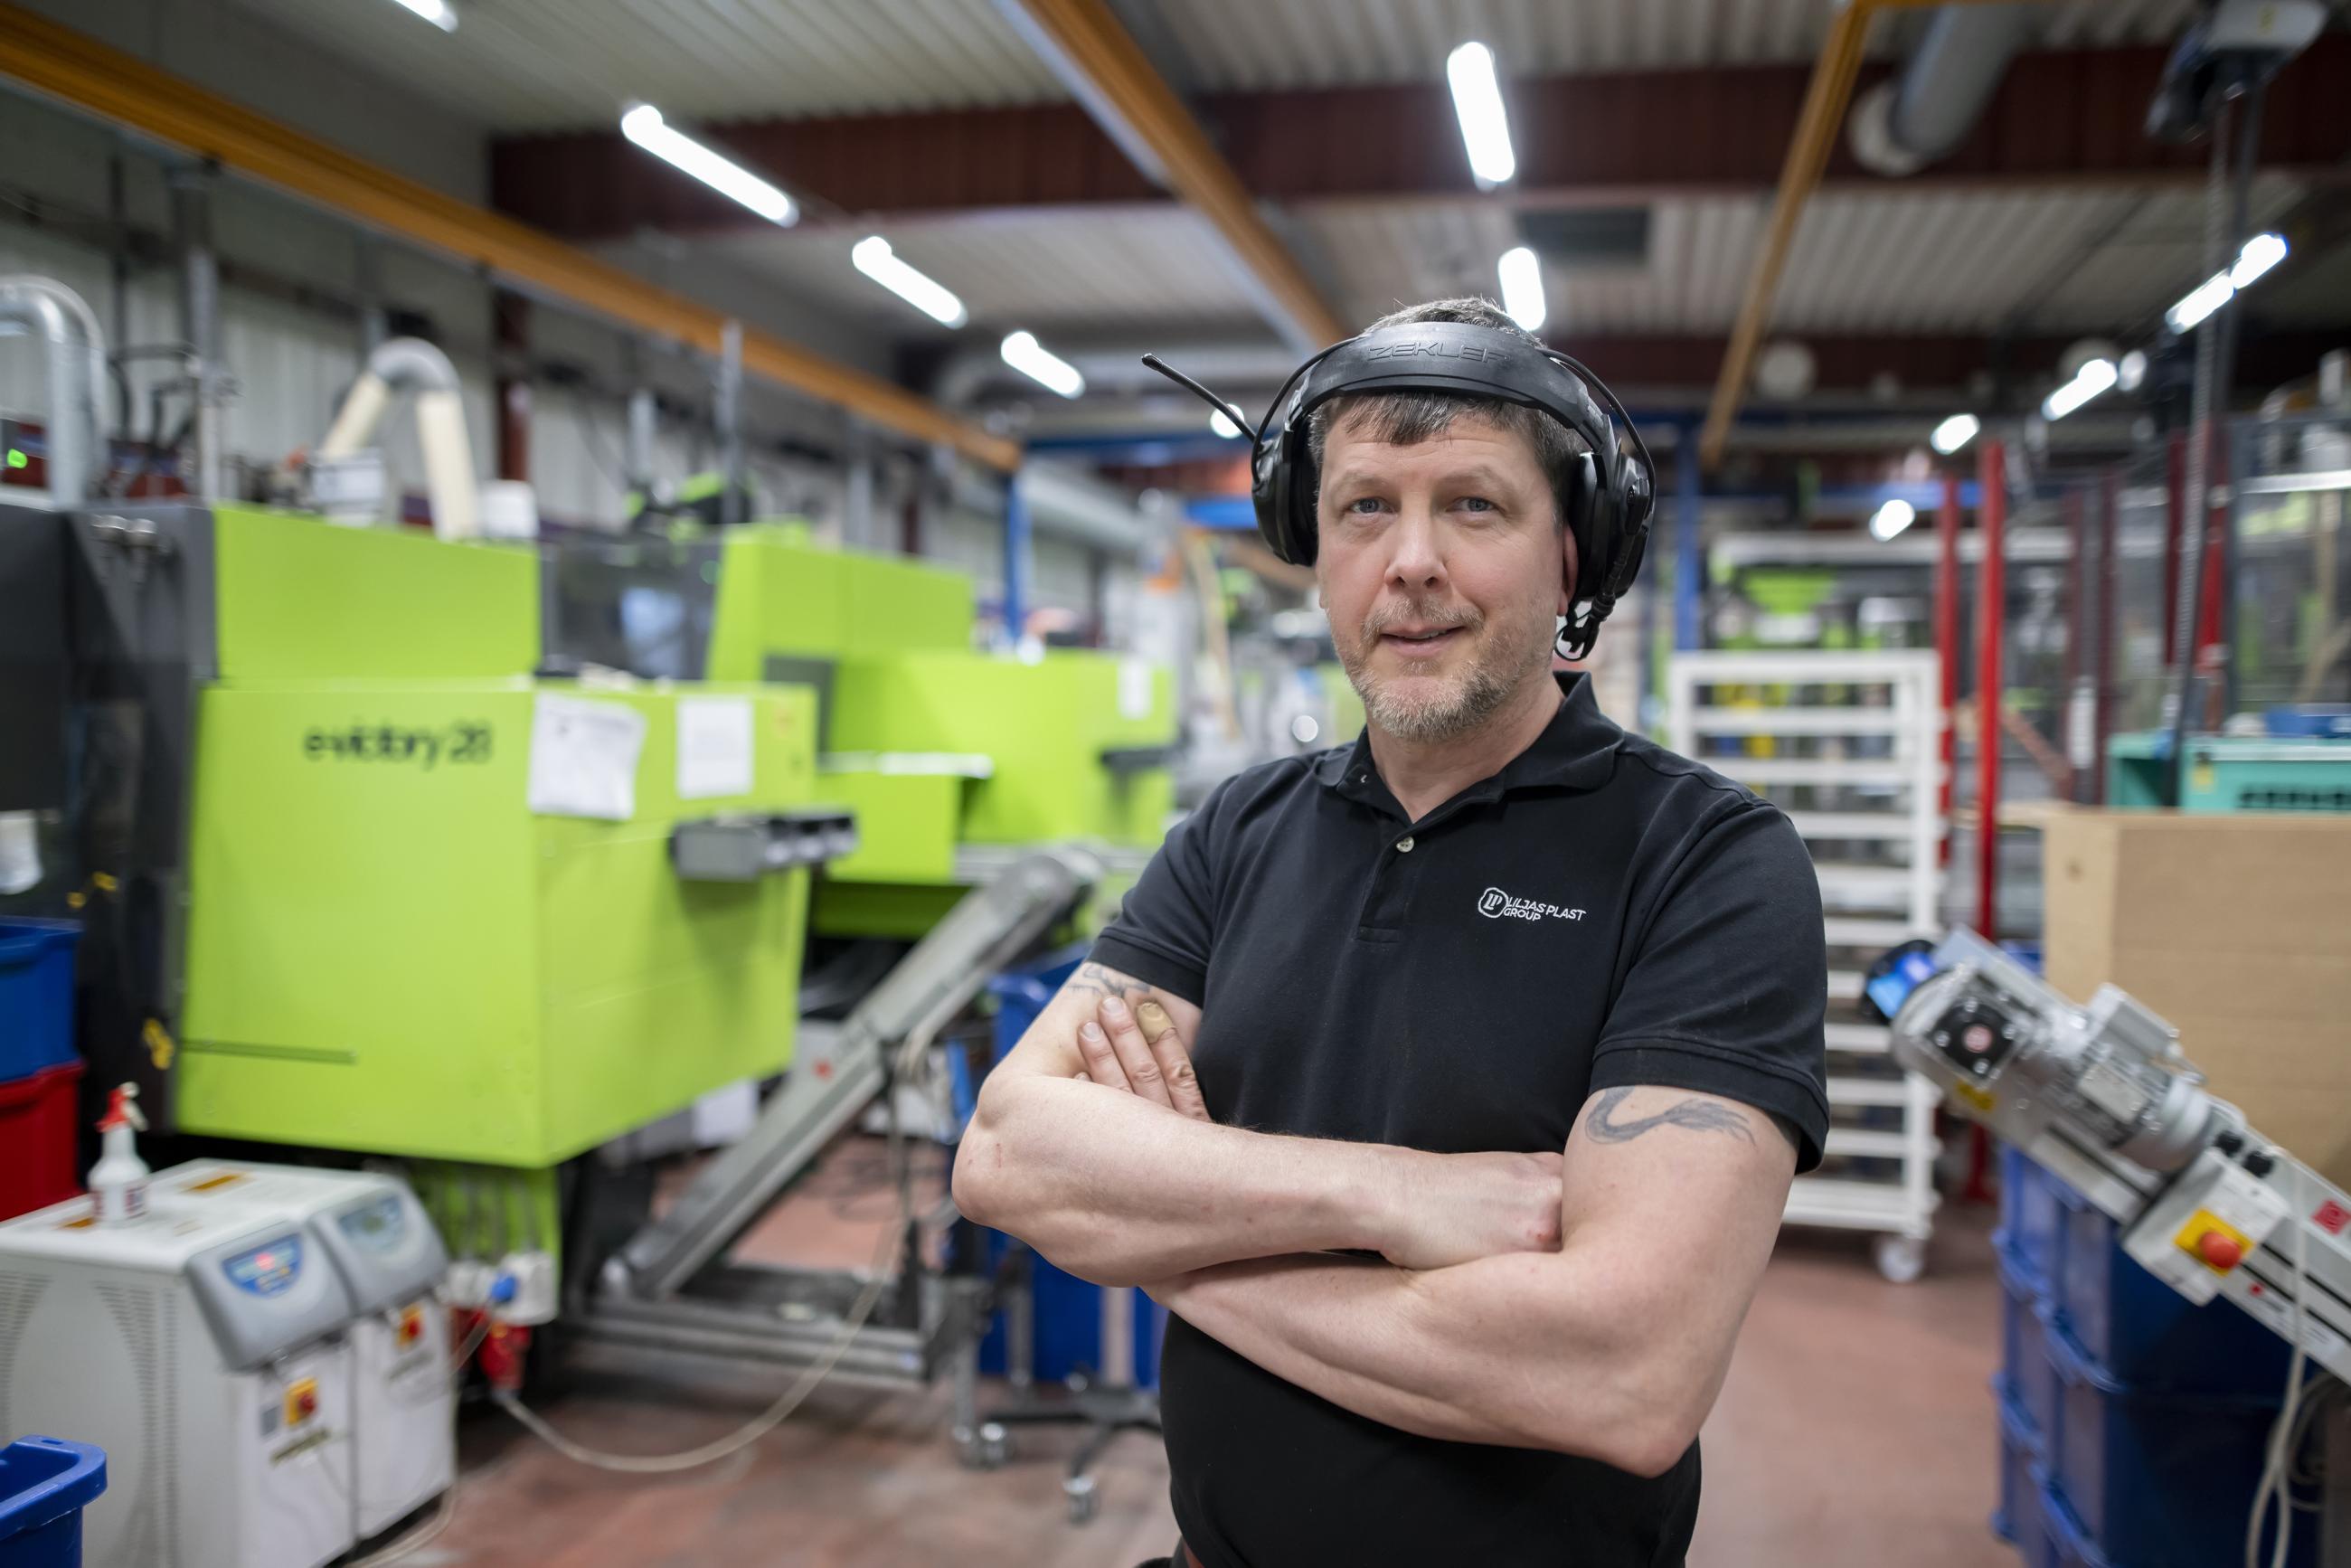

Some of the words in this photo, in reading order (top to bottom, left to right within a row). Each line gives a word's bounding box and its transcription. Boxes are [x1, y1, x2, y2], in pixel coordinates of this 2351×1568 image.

[1503, 907, 1542, 921] GROUP
[1507, 896, 1547, 913] LILJAS
[1545, 904, 1587, 921] PLAST
